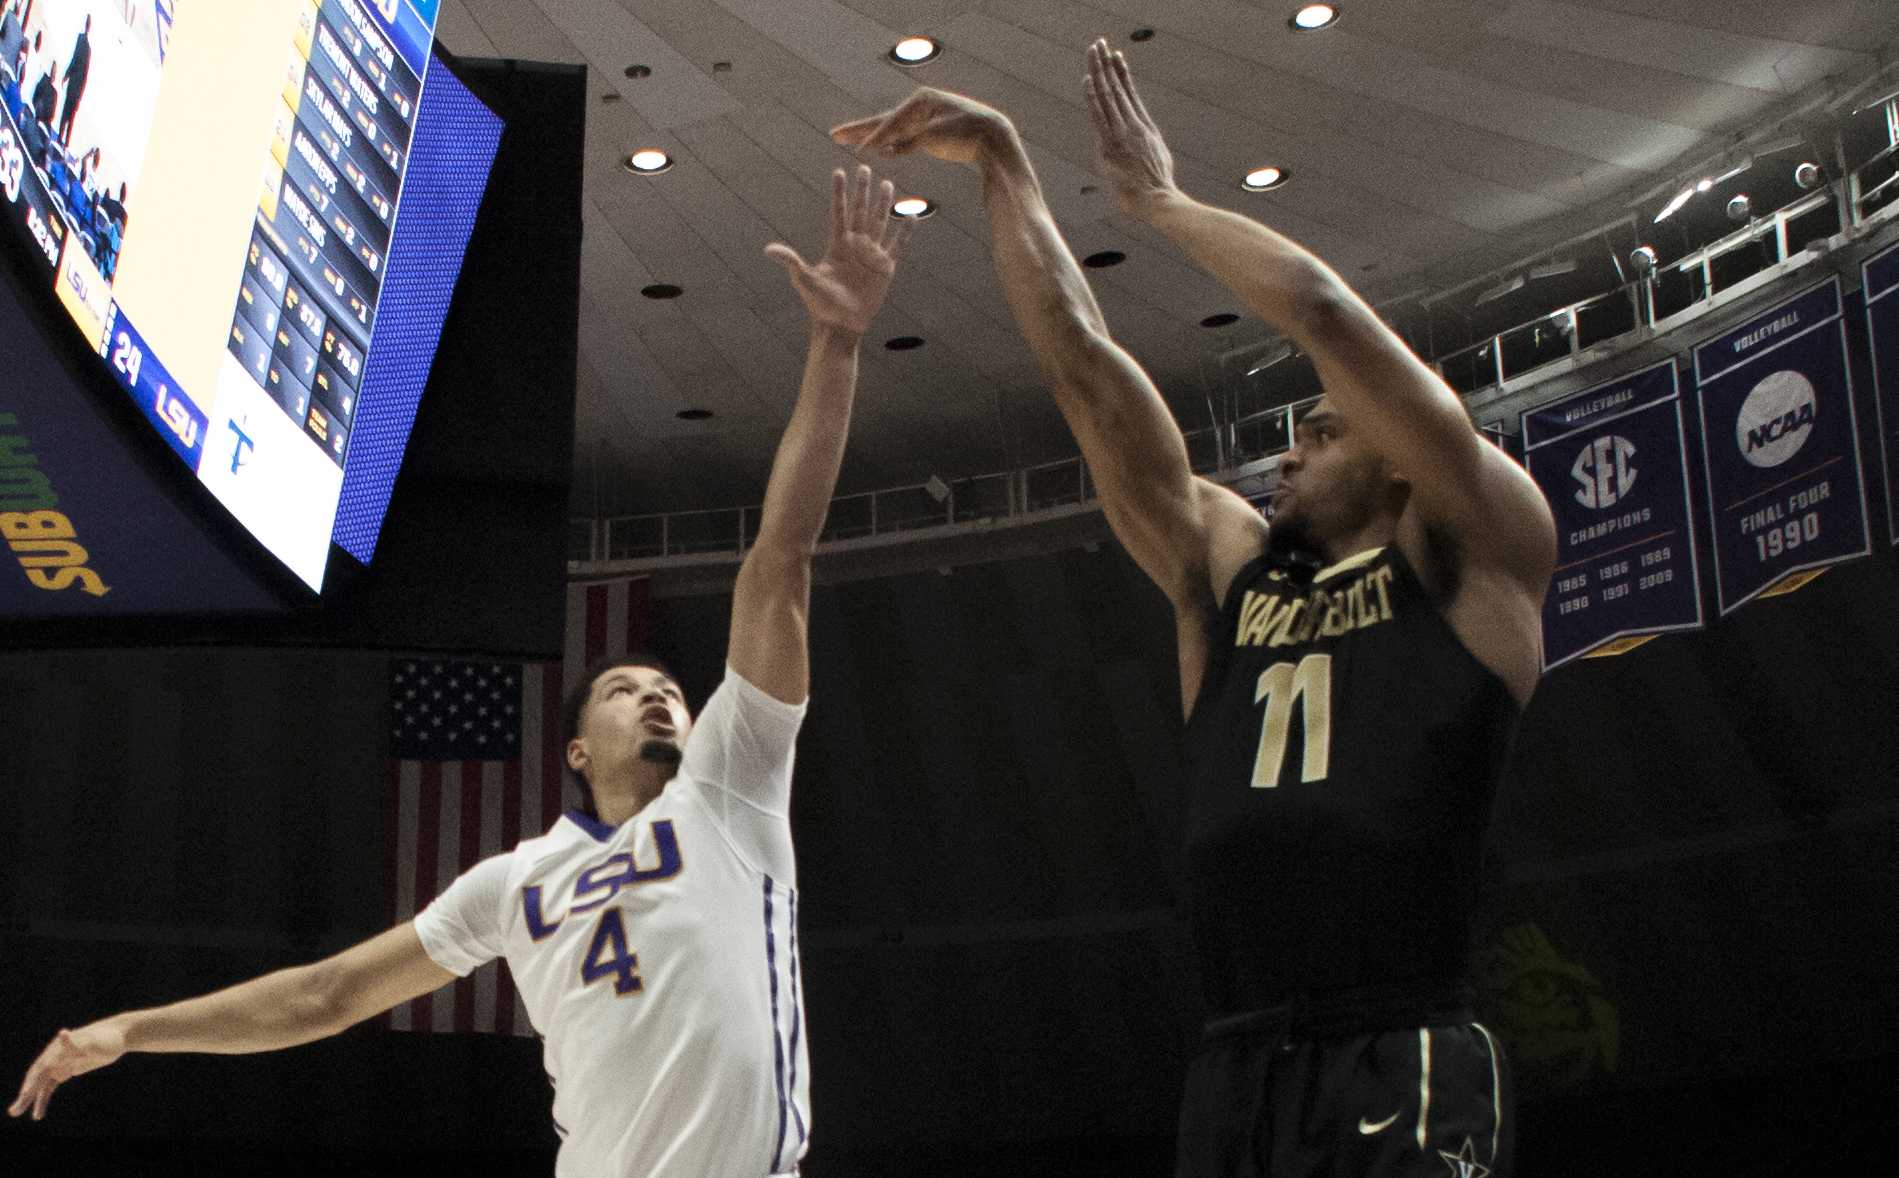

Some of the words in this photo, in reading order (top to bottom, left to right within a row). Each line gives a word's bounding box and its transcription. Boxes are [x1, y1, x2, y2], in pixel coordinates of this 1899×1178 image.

[1732, 310, 1800, 352] VOLLEYBALL
[113, 331, 142, 387] 24
[156, 384, 198, 449] LSU
[1565, 388, 1633, 422] VOLLEYBALL
[1746, 402, 1814, 453] NCAA
[1571, 435, 1638, 510] SEC
[1570, 508, 1651, 546] CHAMPIONS
[1740, 502, 1785, 535] FINAL
[1789, 480, 1831, 512] FOUR
[1755, 511, 1820, 562] 1990
[1251, 653, 1332, 788] 11
[522, 819, 684, 944] LSU
[581, 905, 644, 998] 4
